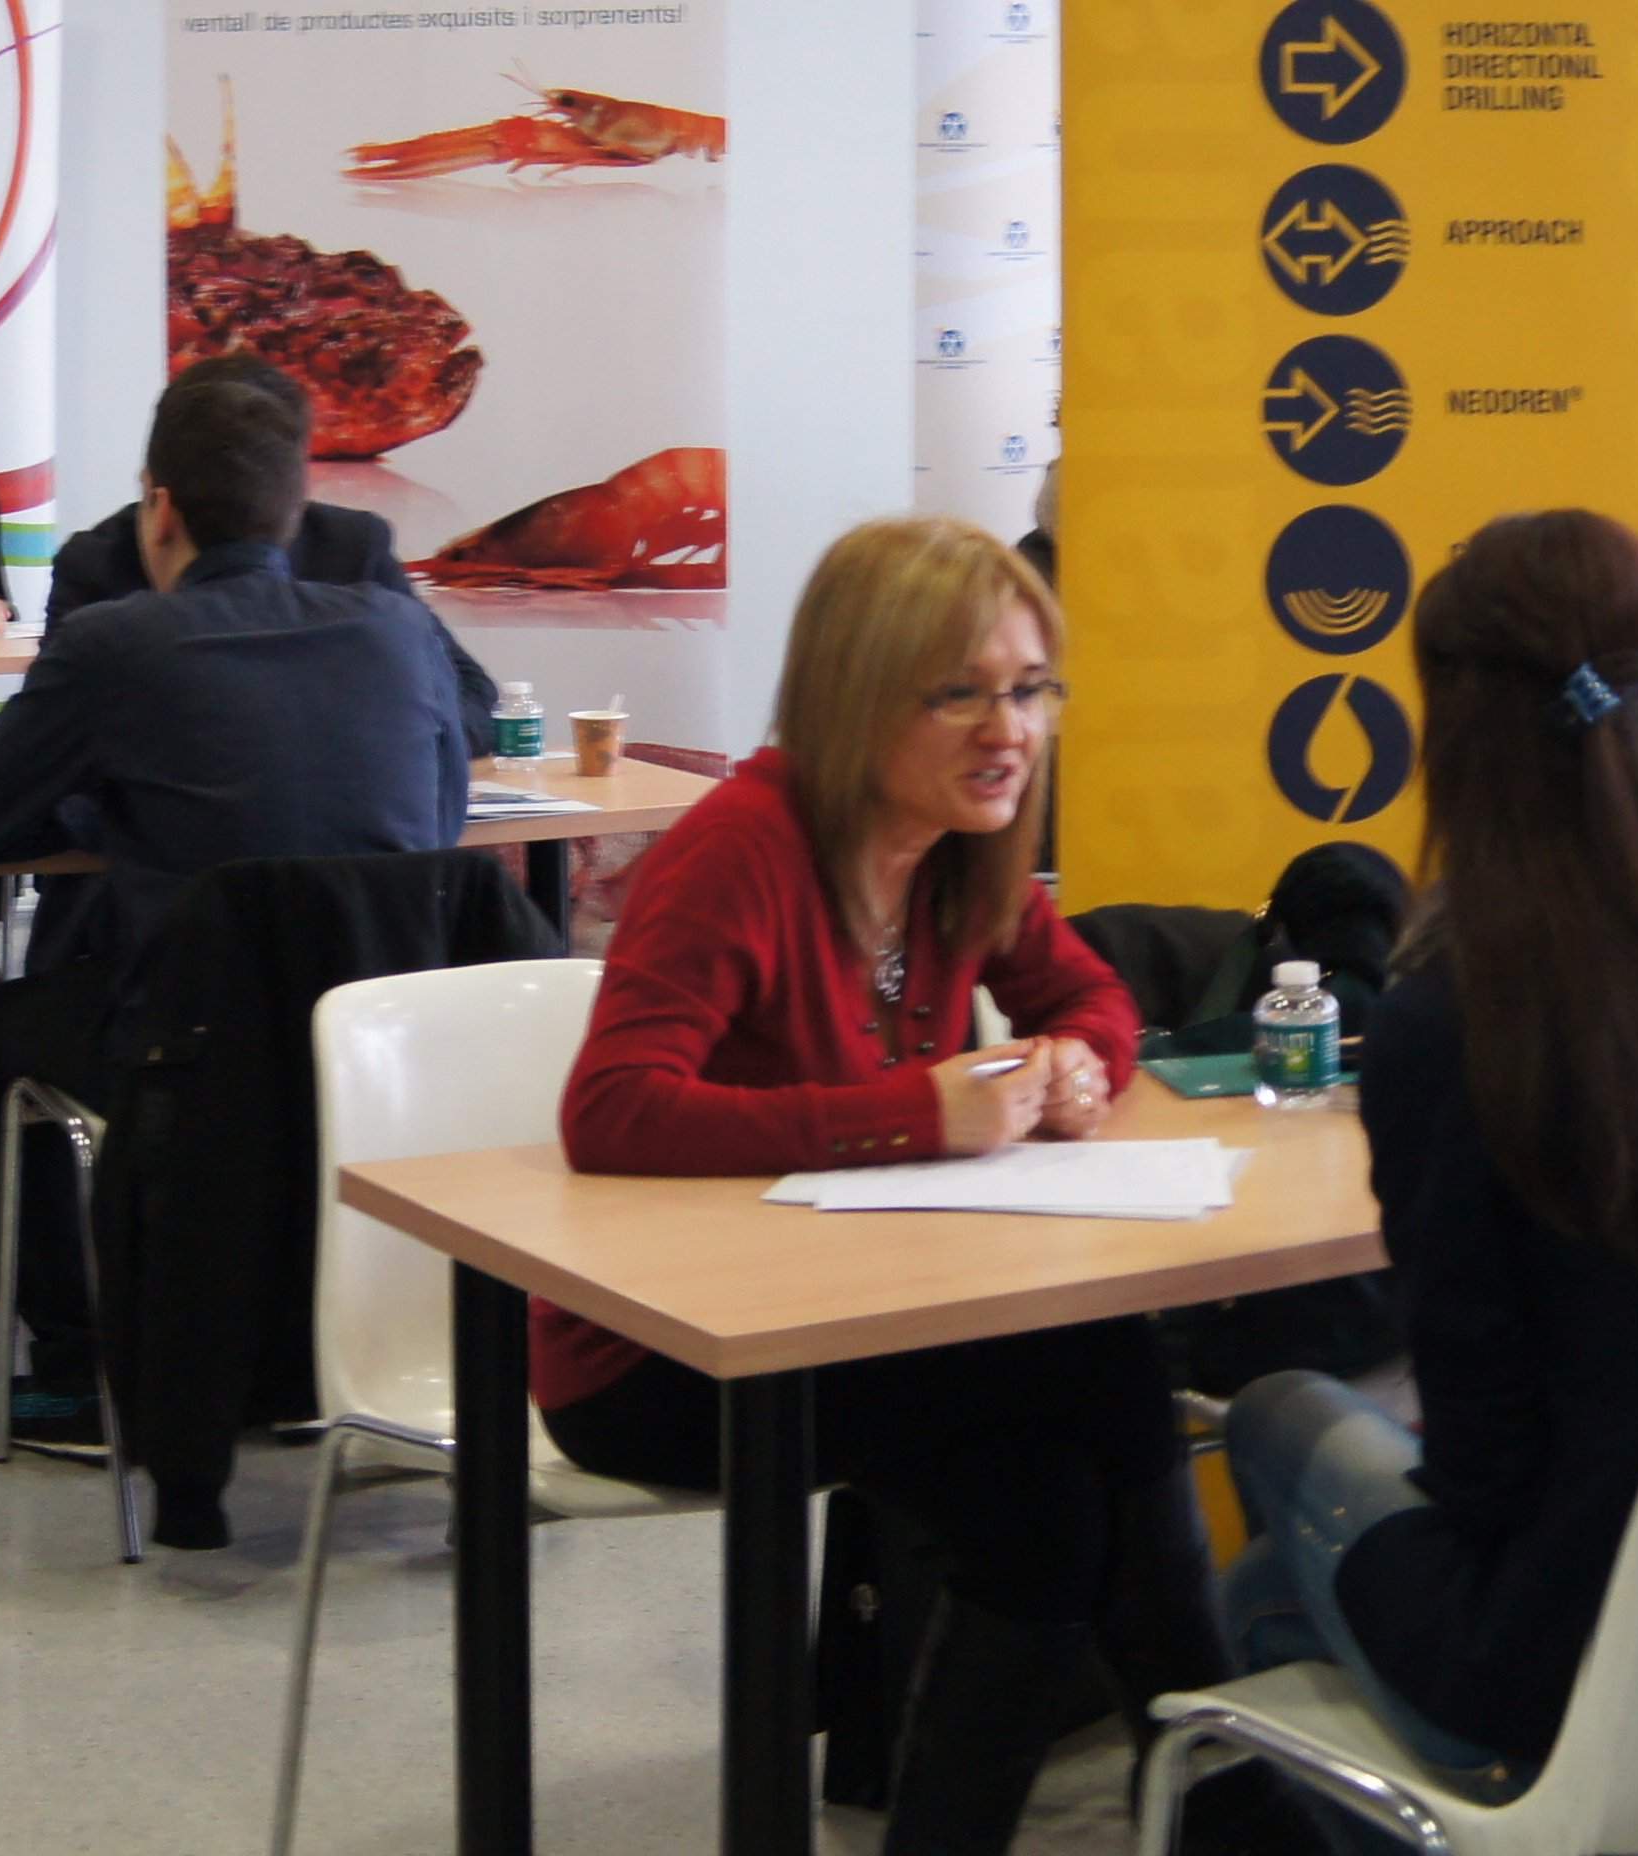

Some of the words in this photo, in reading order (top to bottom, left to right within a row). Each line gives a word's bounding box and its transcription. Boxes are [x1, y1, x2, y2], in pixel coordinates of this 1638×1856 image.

[418, 11, 516, 32] exquisits
[1442, 84, 1566, 112] DRILLING
[1443, 218, 1584, 246] APPROACH
